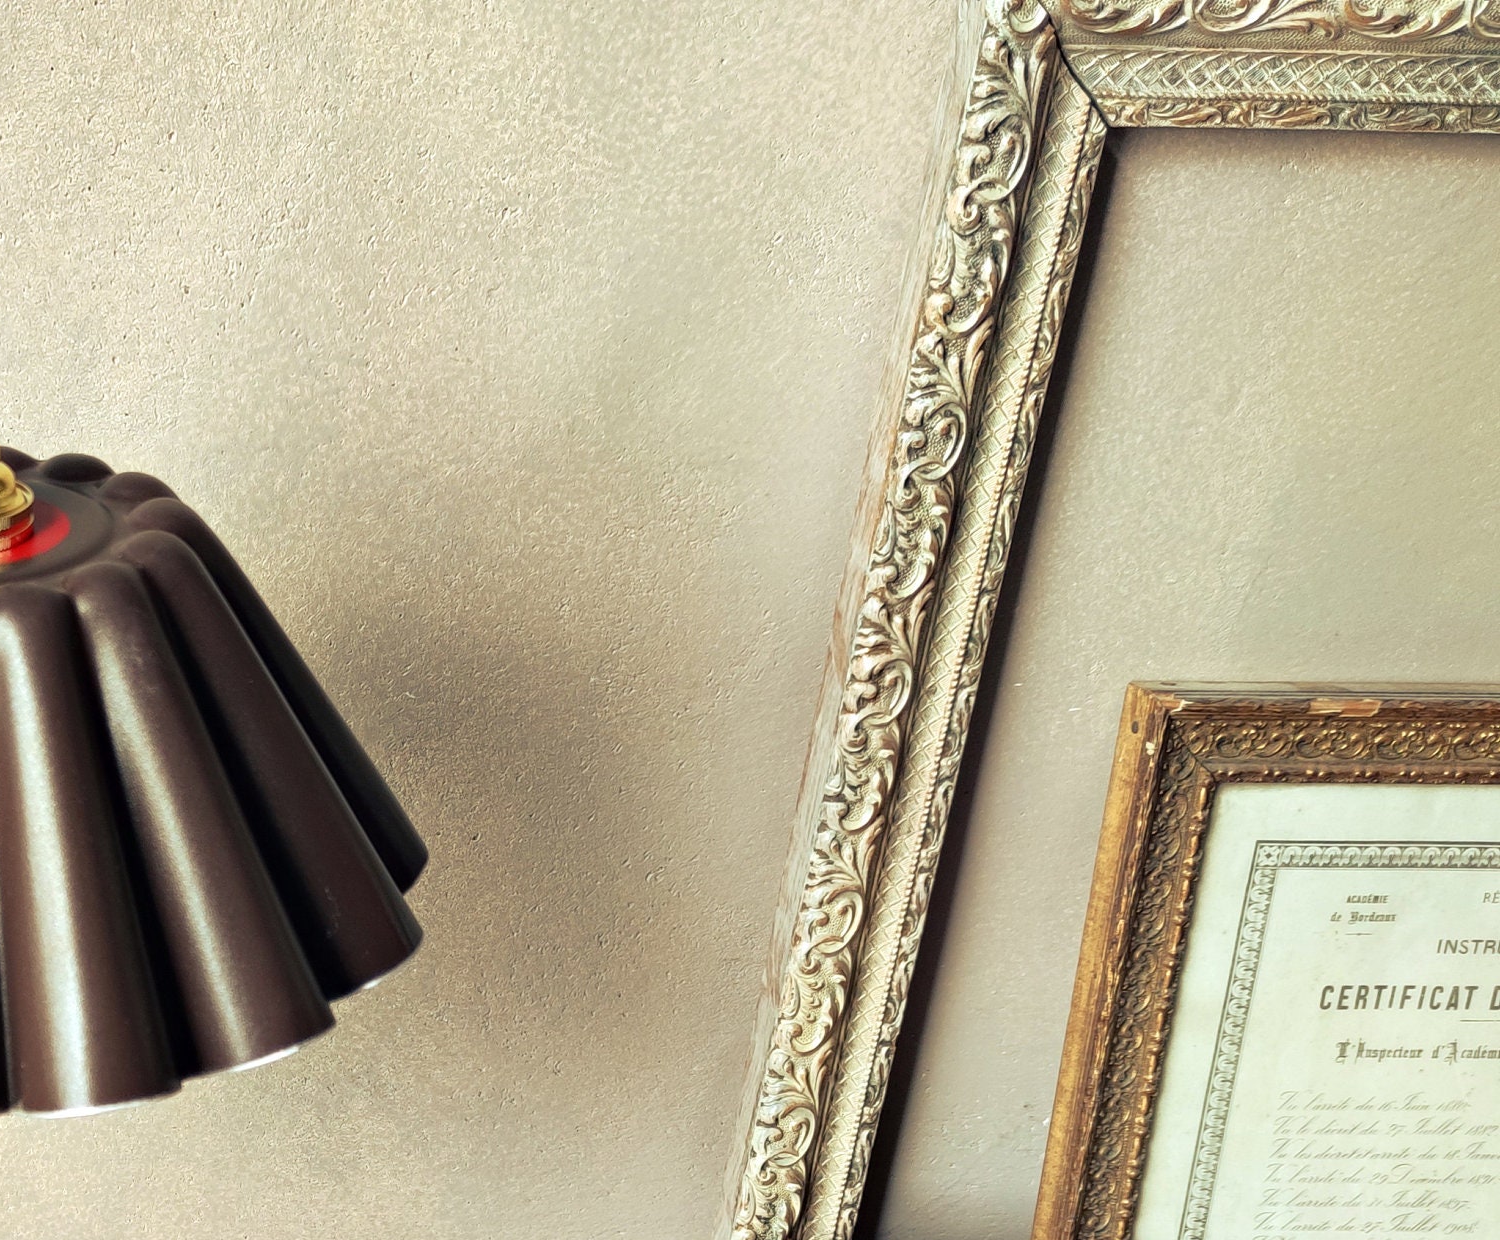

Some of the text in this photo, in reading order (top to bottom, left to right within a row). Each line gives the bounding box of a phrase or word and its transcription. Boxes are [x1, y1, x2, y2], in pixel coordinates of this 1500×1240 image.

[1347, 893, 1389, 904] ACADÉMIE
[1330, 911, 1397, 925] de Bordeaux
[1319, 985, 1479, 1010] CERTIFICAT
